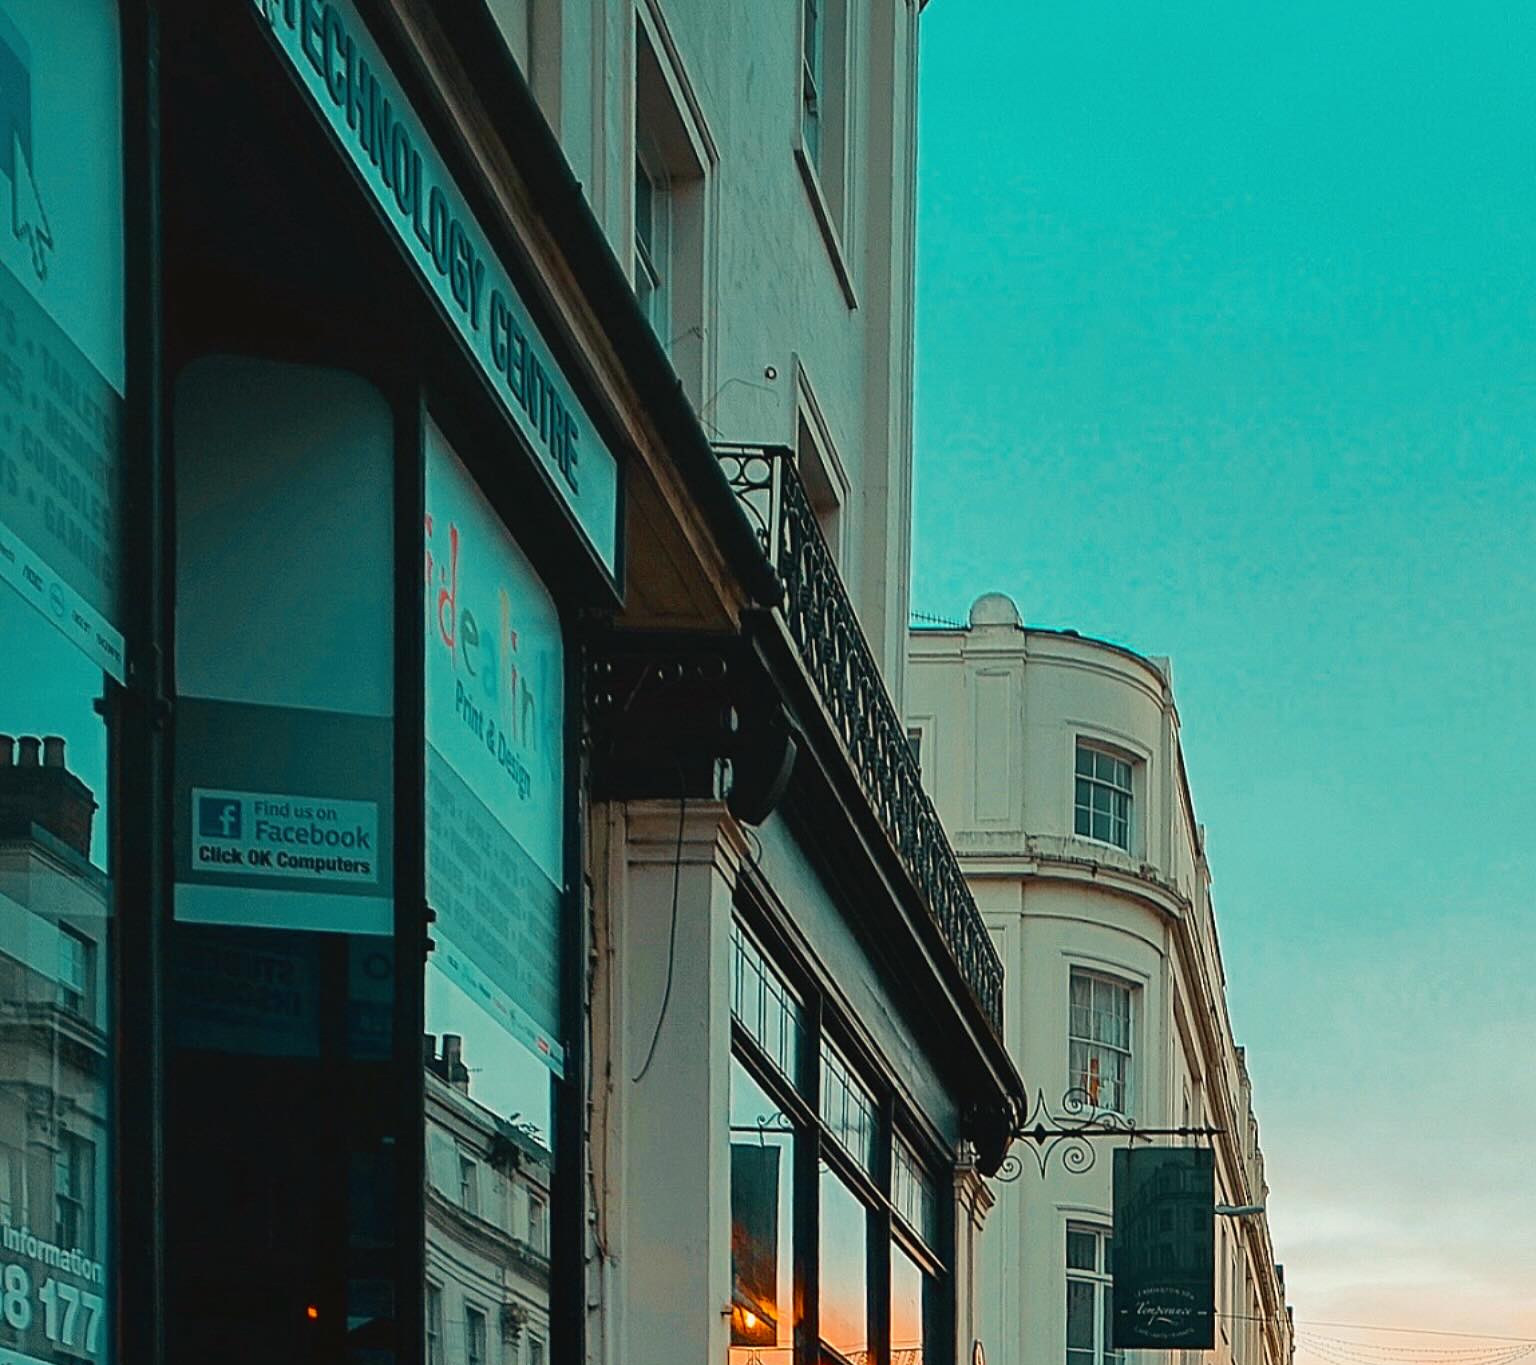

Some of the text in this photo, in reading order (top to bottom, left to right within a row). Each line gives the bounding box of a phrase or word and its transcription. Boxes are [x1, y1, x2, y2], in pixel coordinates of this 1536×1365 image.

[490, 288, 579, 497] CENTRE
[455, 678, 531, 801] Print & Design
[254, 801, 337, 821] Find us on
[256, 820, 370, 849] Facebook
[199, 846, 371, 875] Click OK Computers
[3, 1225, 104, 1284] information
[0, 1262, 104, 1353] 8 177
